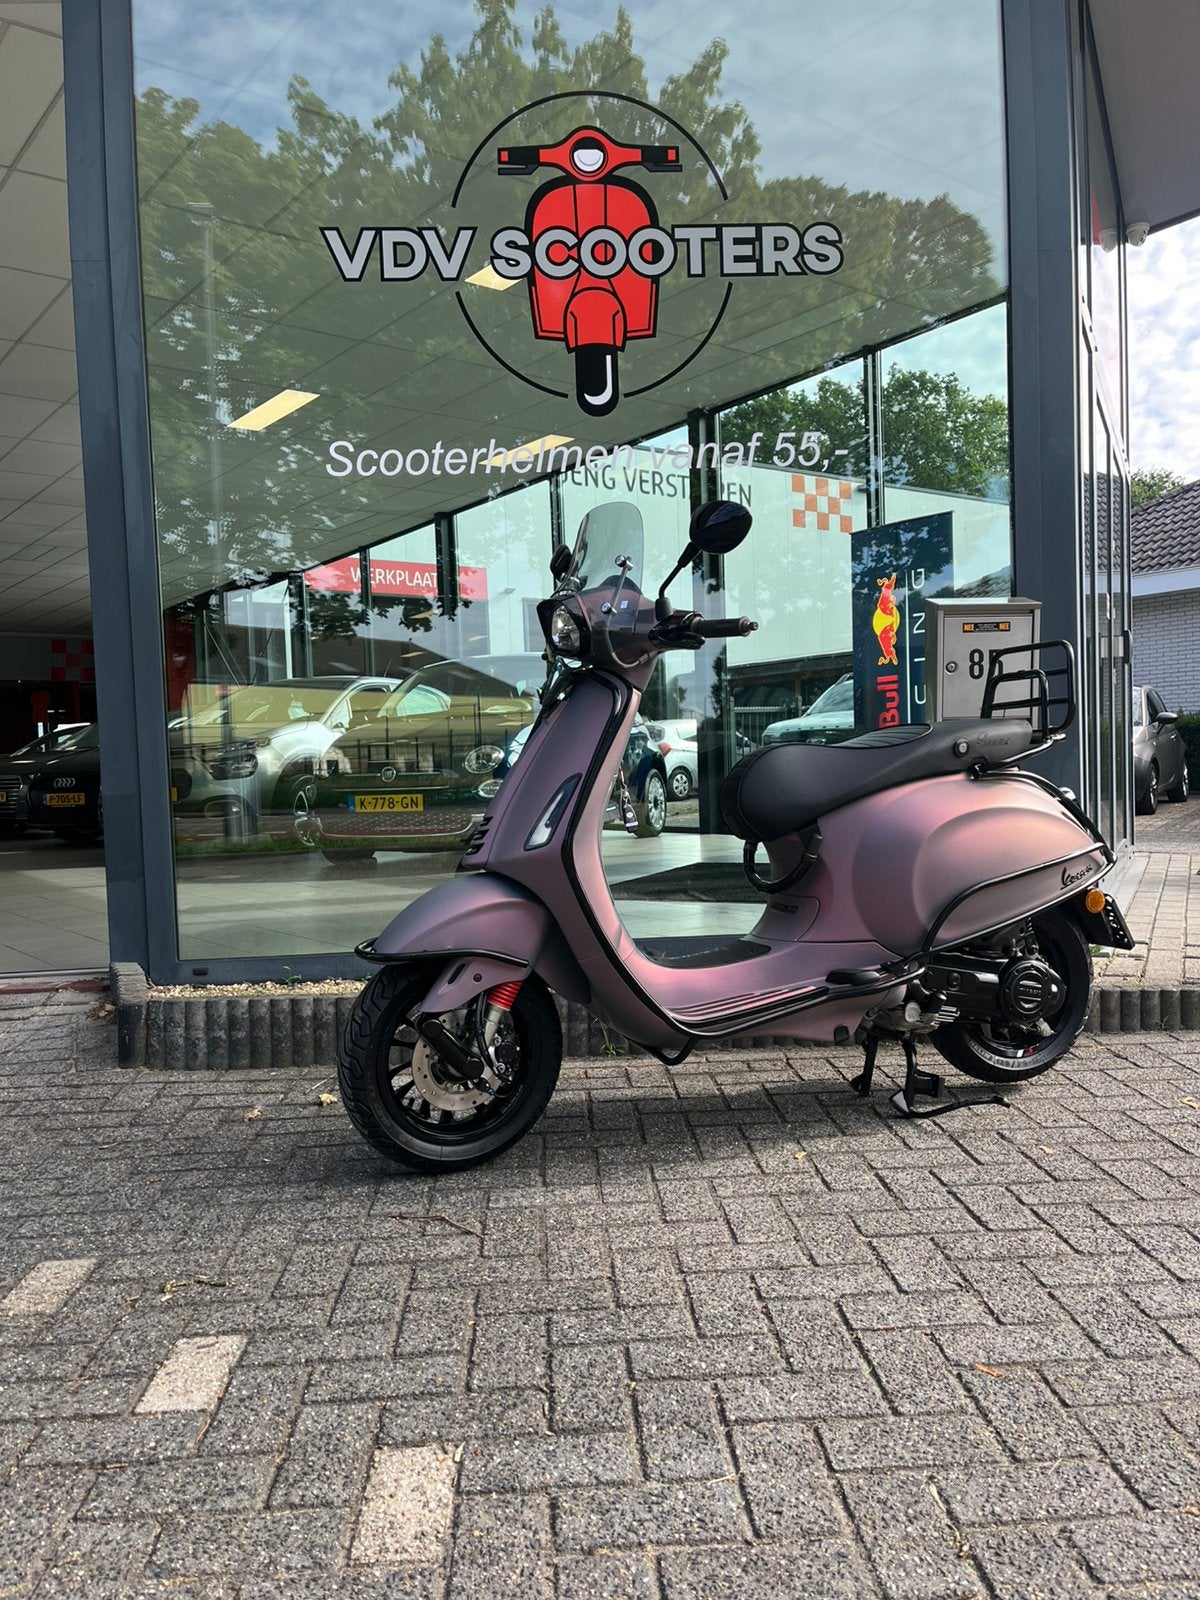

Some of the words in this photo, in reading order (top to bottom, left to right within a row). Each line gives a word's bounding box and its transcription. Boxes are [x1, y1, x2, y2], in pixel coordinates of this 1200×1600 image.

[319, 226, 478, 282] VDV
[490, 221, 844, 280] SCOOTERS
[325, 438, 634, 477] Scooterhelmen
[650, 431, 763, 470] vanaf
[359, 796, 419, 809] K-778-GN
